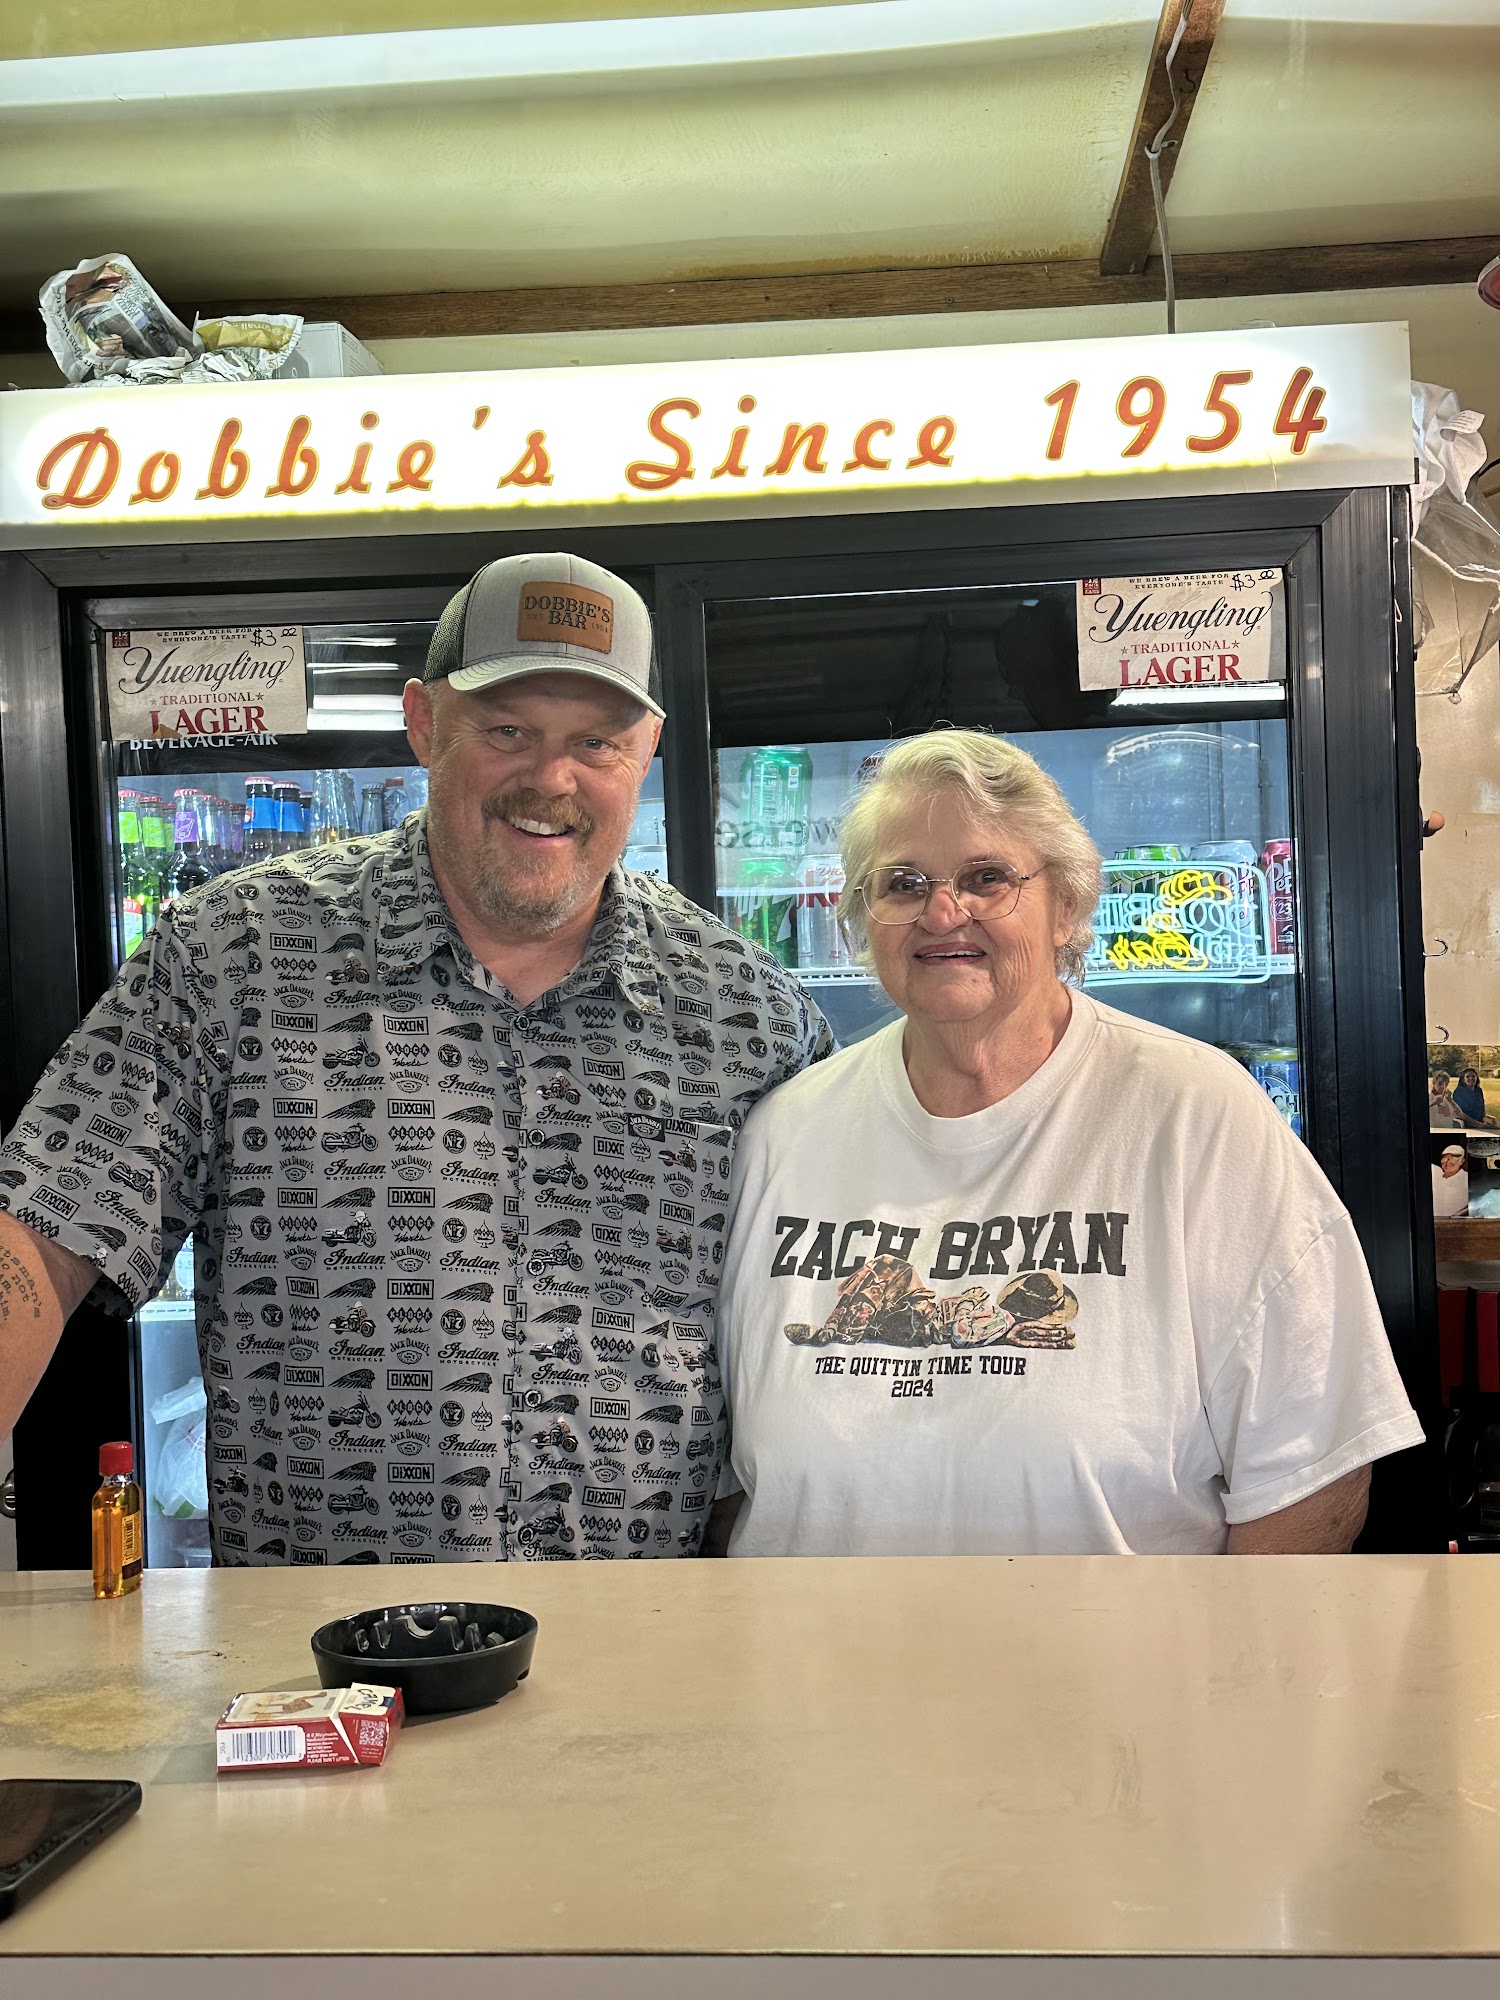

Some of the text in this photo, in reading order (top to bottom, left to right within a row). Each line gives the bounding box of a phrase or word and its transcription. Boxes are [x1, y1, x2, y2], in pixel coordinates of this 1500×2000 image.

[36, 365, 1328, 510] Dobbie's Since 1954
[525, 596, 610, 622] DOBBIE'S
[1089, 591, 1273, 643] Yuengling
[548, 611, 587, 630] BAR
[1131, 641, 1230, 654] TRADITIONAL
[119, 646, 294, 694] Yuengling
[1119, 654, 1242, 686] LAGER
[160, 692, 255, 705] TRADITIONAL
[150, 706, 268, 737] LAGER
[270, 956, 317, 972] KLOCK
[678, 1000, 709, 1018] DIXXON
[276, 1015, 314, 1029] DIXXON
[387, 1018, 424, 1032] DIXXON
[271, 1037, 317, 1056] KLOCK
[386, 1041, 430, 1057] KLOCK
[390, 1071, 403, 1081] JACK
[588, 1063, 620, 1076] DIXXON
[324, 1071, 385, 1087] Indian
[438, 1074, 496, 1096] Indian
[681, 1082, 715, 1094] DIXXON
[277, 1102, 313, 1114] DIXXON
[392, 1103, 431, 1116] DIXXON
[536, 1103, 593, 1124] Indian
[274, 1126, 317, 1142] KLOCK
[388, 1126, 436, 1142] KLOCK
[324, 1158, 386, 1176] Indian
[391, 1157, 406, 1170] JACK
[440, 1161, 499, 1182] Indian
[36, 1188, 75, 1216] DIXXON
[281, 1191, 314, 1204] DIXXON
[392, 1191, 431, 1204] DIXXON
[535, 1188, 592, 1209] Indian
[95, 1190, 148, 1231] Indian
[664, 1203, 692, 1221] DIXXON
[388, 1215, 435, 1231] KLOCK
[390, 1248, 406, 1260] JACK
[770, 1211, 1129, 1281] ZACH BRYAN
[226, 1246, 279, 1264] Indian
[324, 1249, 386, 1266] Indian
[440, 1250, 500, 1270] Indian
[392, 1283, 430, 1296] DIXXON
[533, 1275, 590, 1296] Indian
[595, 1282, 610, 1292] JACK
[387, 1307, 433, 1323] KLOCK
[597, 1311, 631, 1328] DIXXON
[329, 1339, 386, 1357] Indian
[390, 1341, 405, 1352] JACK
[438, 1342, 499, 1361] Indian
[591, 1335, 635, 1354] KLOCK
[532, 1363, 590, 1383] Indian
[815, 1355, 1026, 1376] THE QUITTIN TIME TOUR
[286, 1370, 320, 1383] DIXXON
[392, 1373, 428, 1387] DIXXON
[635, 1374, 688, 1392] Indian
[891, 1379, 934, 1397] 2024
[387, 1399, 433, 1415] KLOCK
[594, 1401, 627, 1416] DIXXON
[329, 1429, 386, 1448] Indian
[390, 1432, 405, 1444] JACK
[589, 1425, 628, 1443] KLOCK
[439, 1434, 497, 1453] Indian
[590, 1459, 603, 1470] JACK
[632, 1462, 681, 1481] Indian
[392, 1467, 430, 1480] DIXXON
[389, 1491, 434, 1507] KLOCK
[588, 1490, 622, 1506] DIXXON
[332, 1521, 389, 1539] Indian
[392, 1524, 406, 1535] JACK
[439, 1528, 492, 1546] Indian
